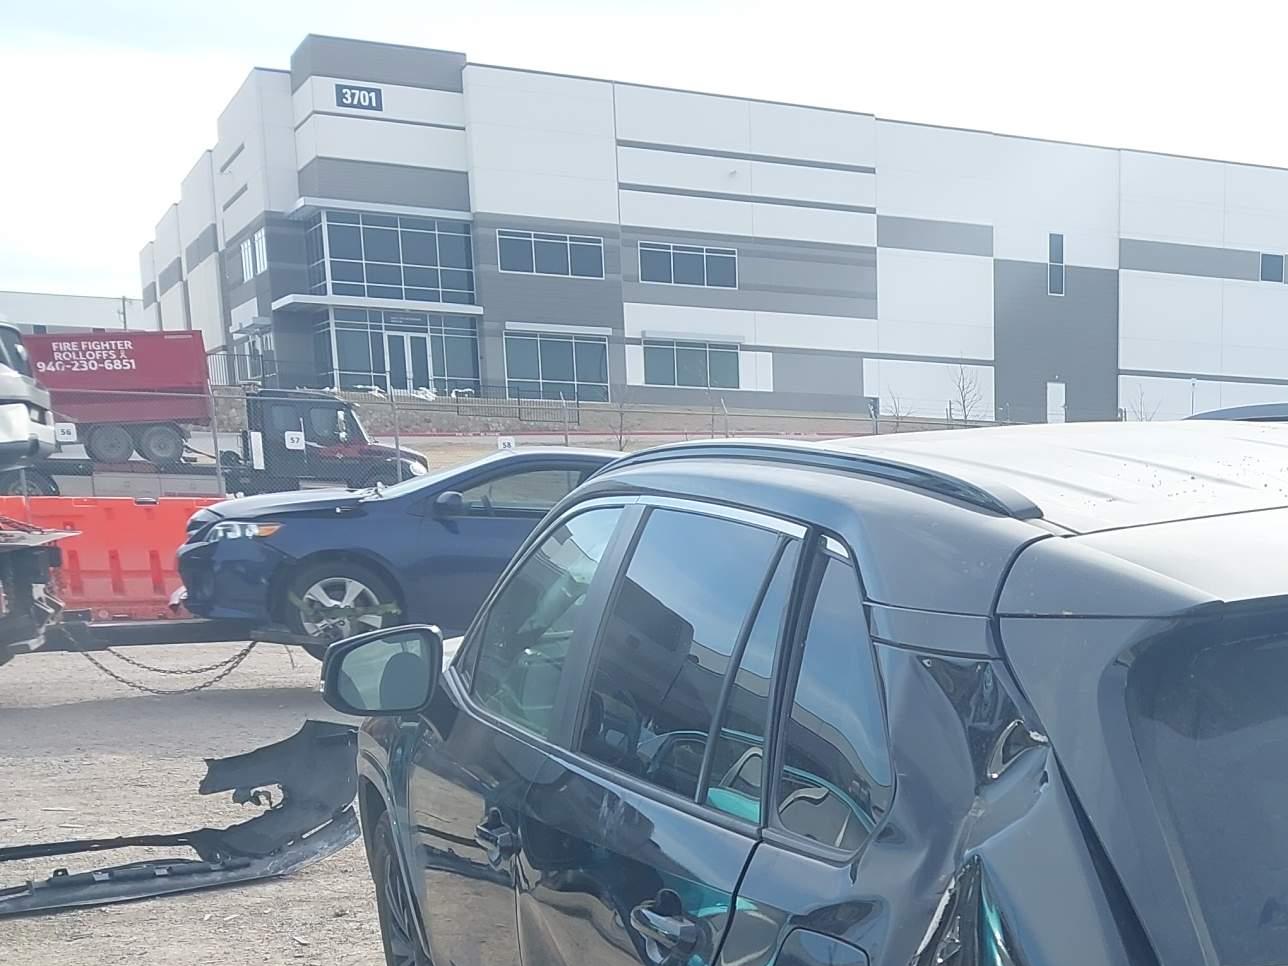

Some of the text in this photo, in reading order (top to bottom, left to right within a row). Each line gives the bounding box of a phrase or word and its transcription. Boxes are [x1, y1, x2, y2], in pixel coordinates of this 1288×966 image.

[342, 88, 376, 107] 3701
[52, 341, 133, 351] FIRE FIGHTER
[54, 351, 116, 360] ROLLOFFS
[36, 359, 136, 372] 940-230-6851
